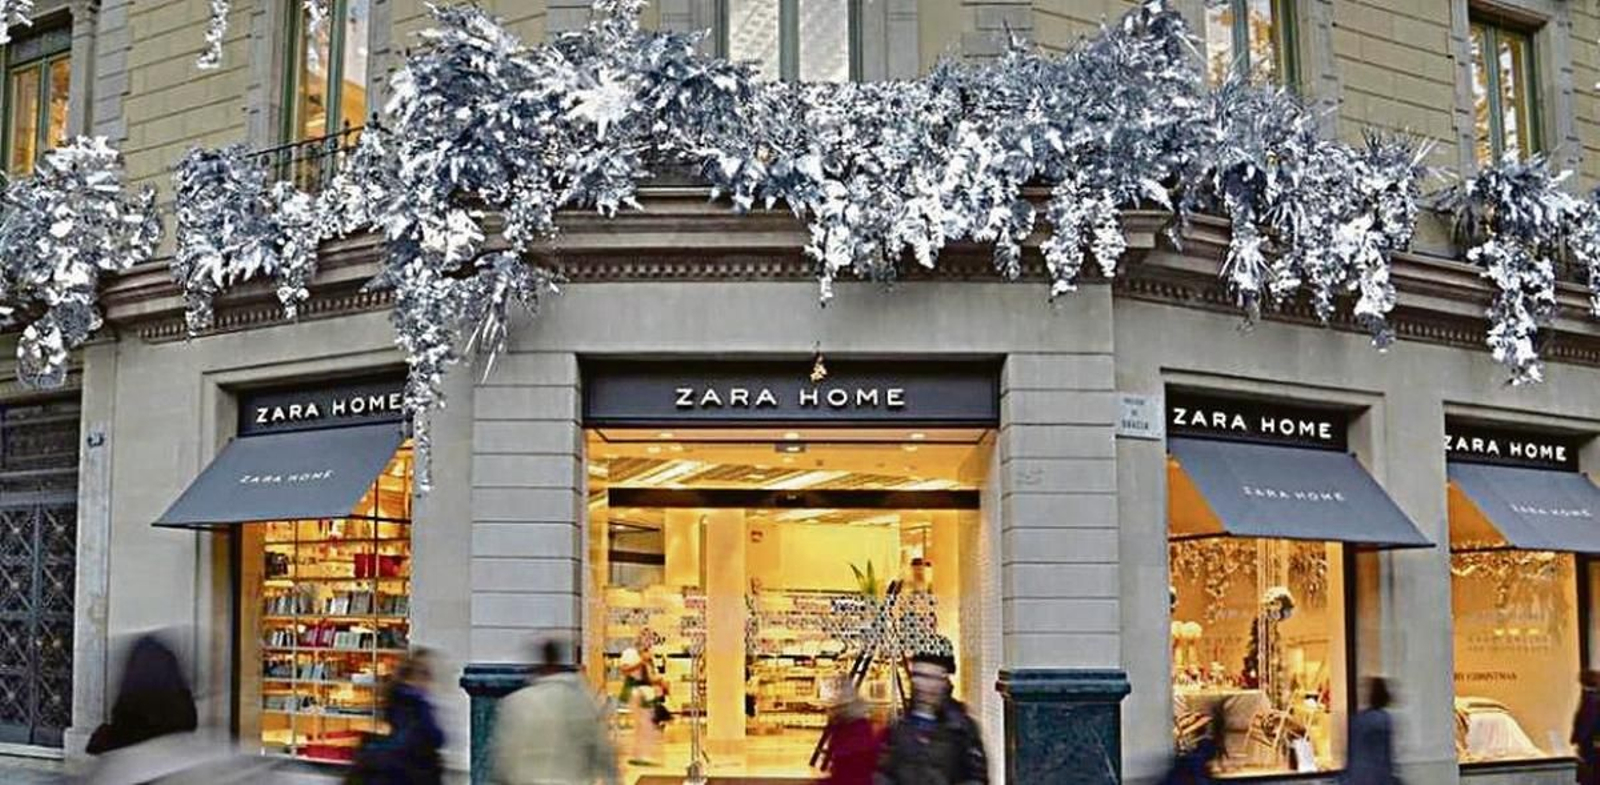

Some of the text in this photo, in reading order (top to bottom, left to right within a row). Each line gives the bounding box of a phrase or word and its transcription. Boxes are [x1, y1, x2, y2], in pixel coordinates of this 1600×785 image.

[256, 393, 401, 423] ZARA HOME
[675, 388, 905, 406] ZARA HOME
[1173, 408, 1332, 439] ZARA HOME
[1443, 435, 1567, 462] ZARA HOME
[239, 474, 281, 484] ZARA
[1242, 485, 1345, 502] ZARA HOME
